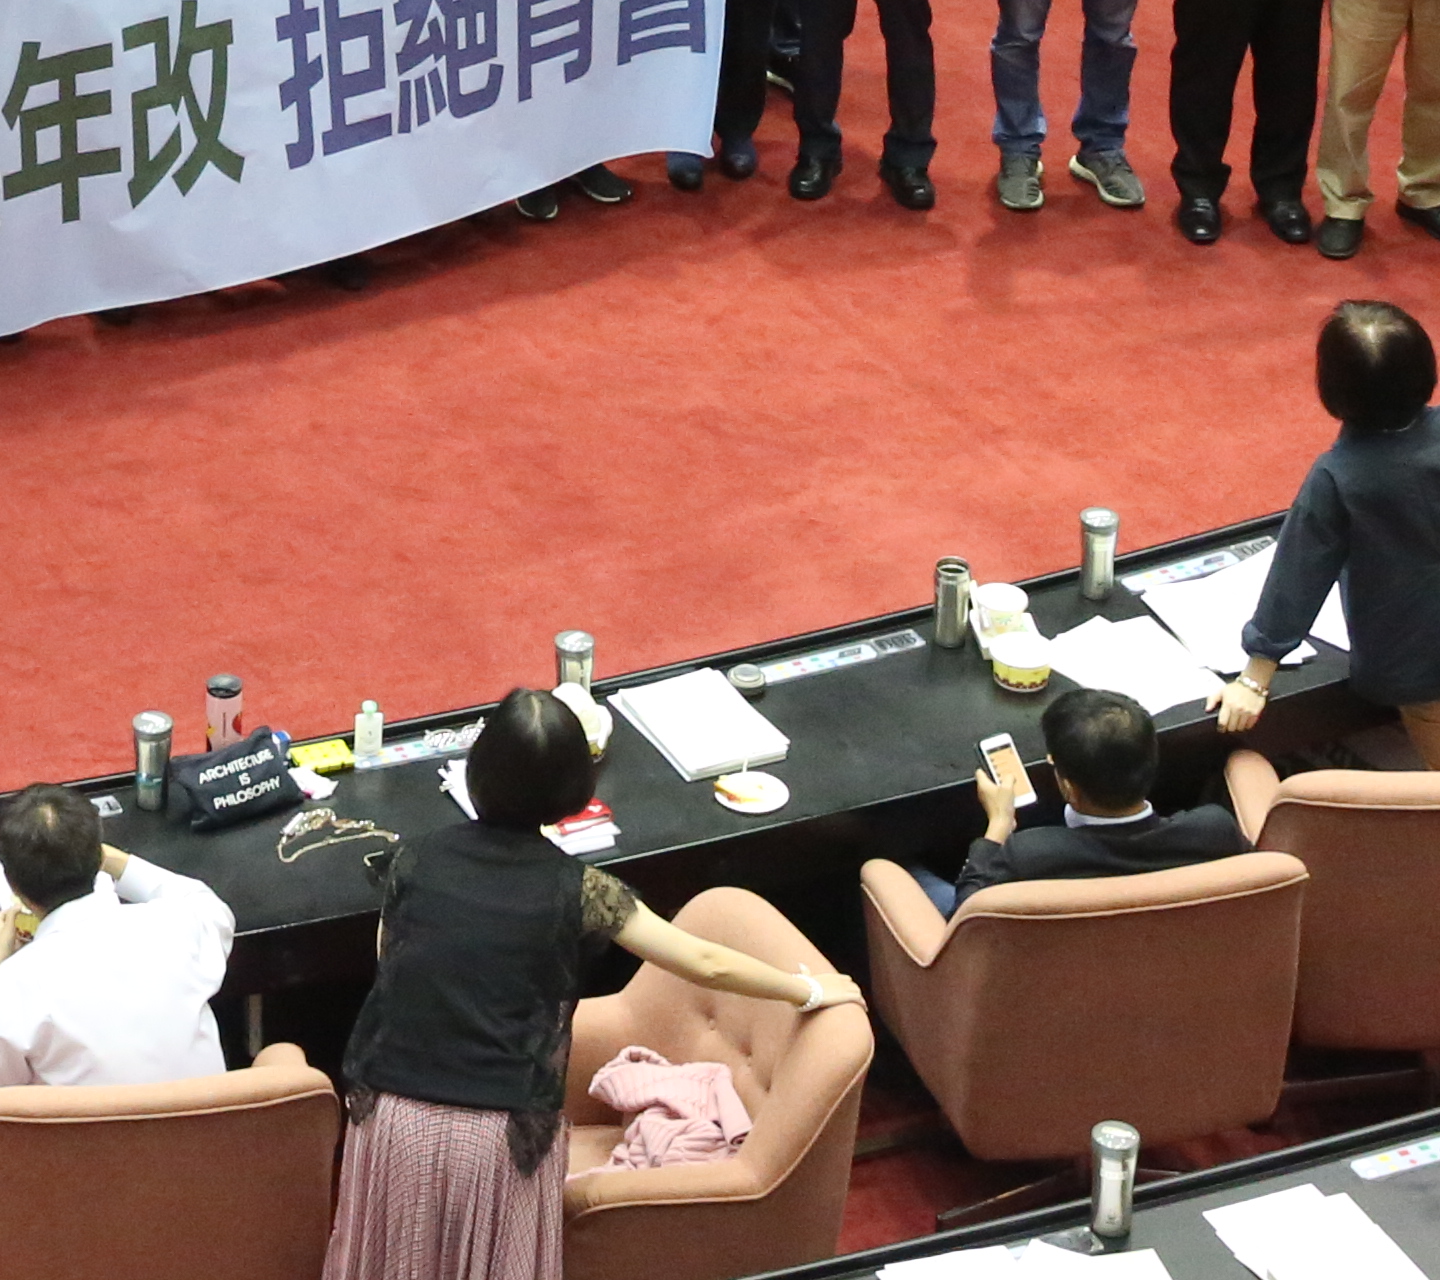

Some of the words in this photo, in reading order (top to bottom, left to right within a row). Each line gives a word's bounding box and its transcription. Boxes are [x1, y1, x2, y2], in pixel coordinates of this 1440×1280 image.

[199, 748, 275, 785] ARCHITECTURE
[238, 774, 252, 787] IS
[213, 776, 281, 810] PHILOSOPHY
